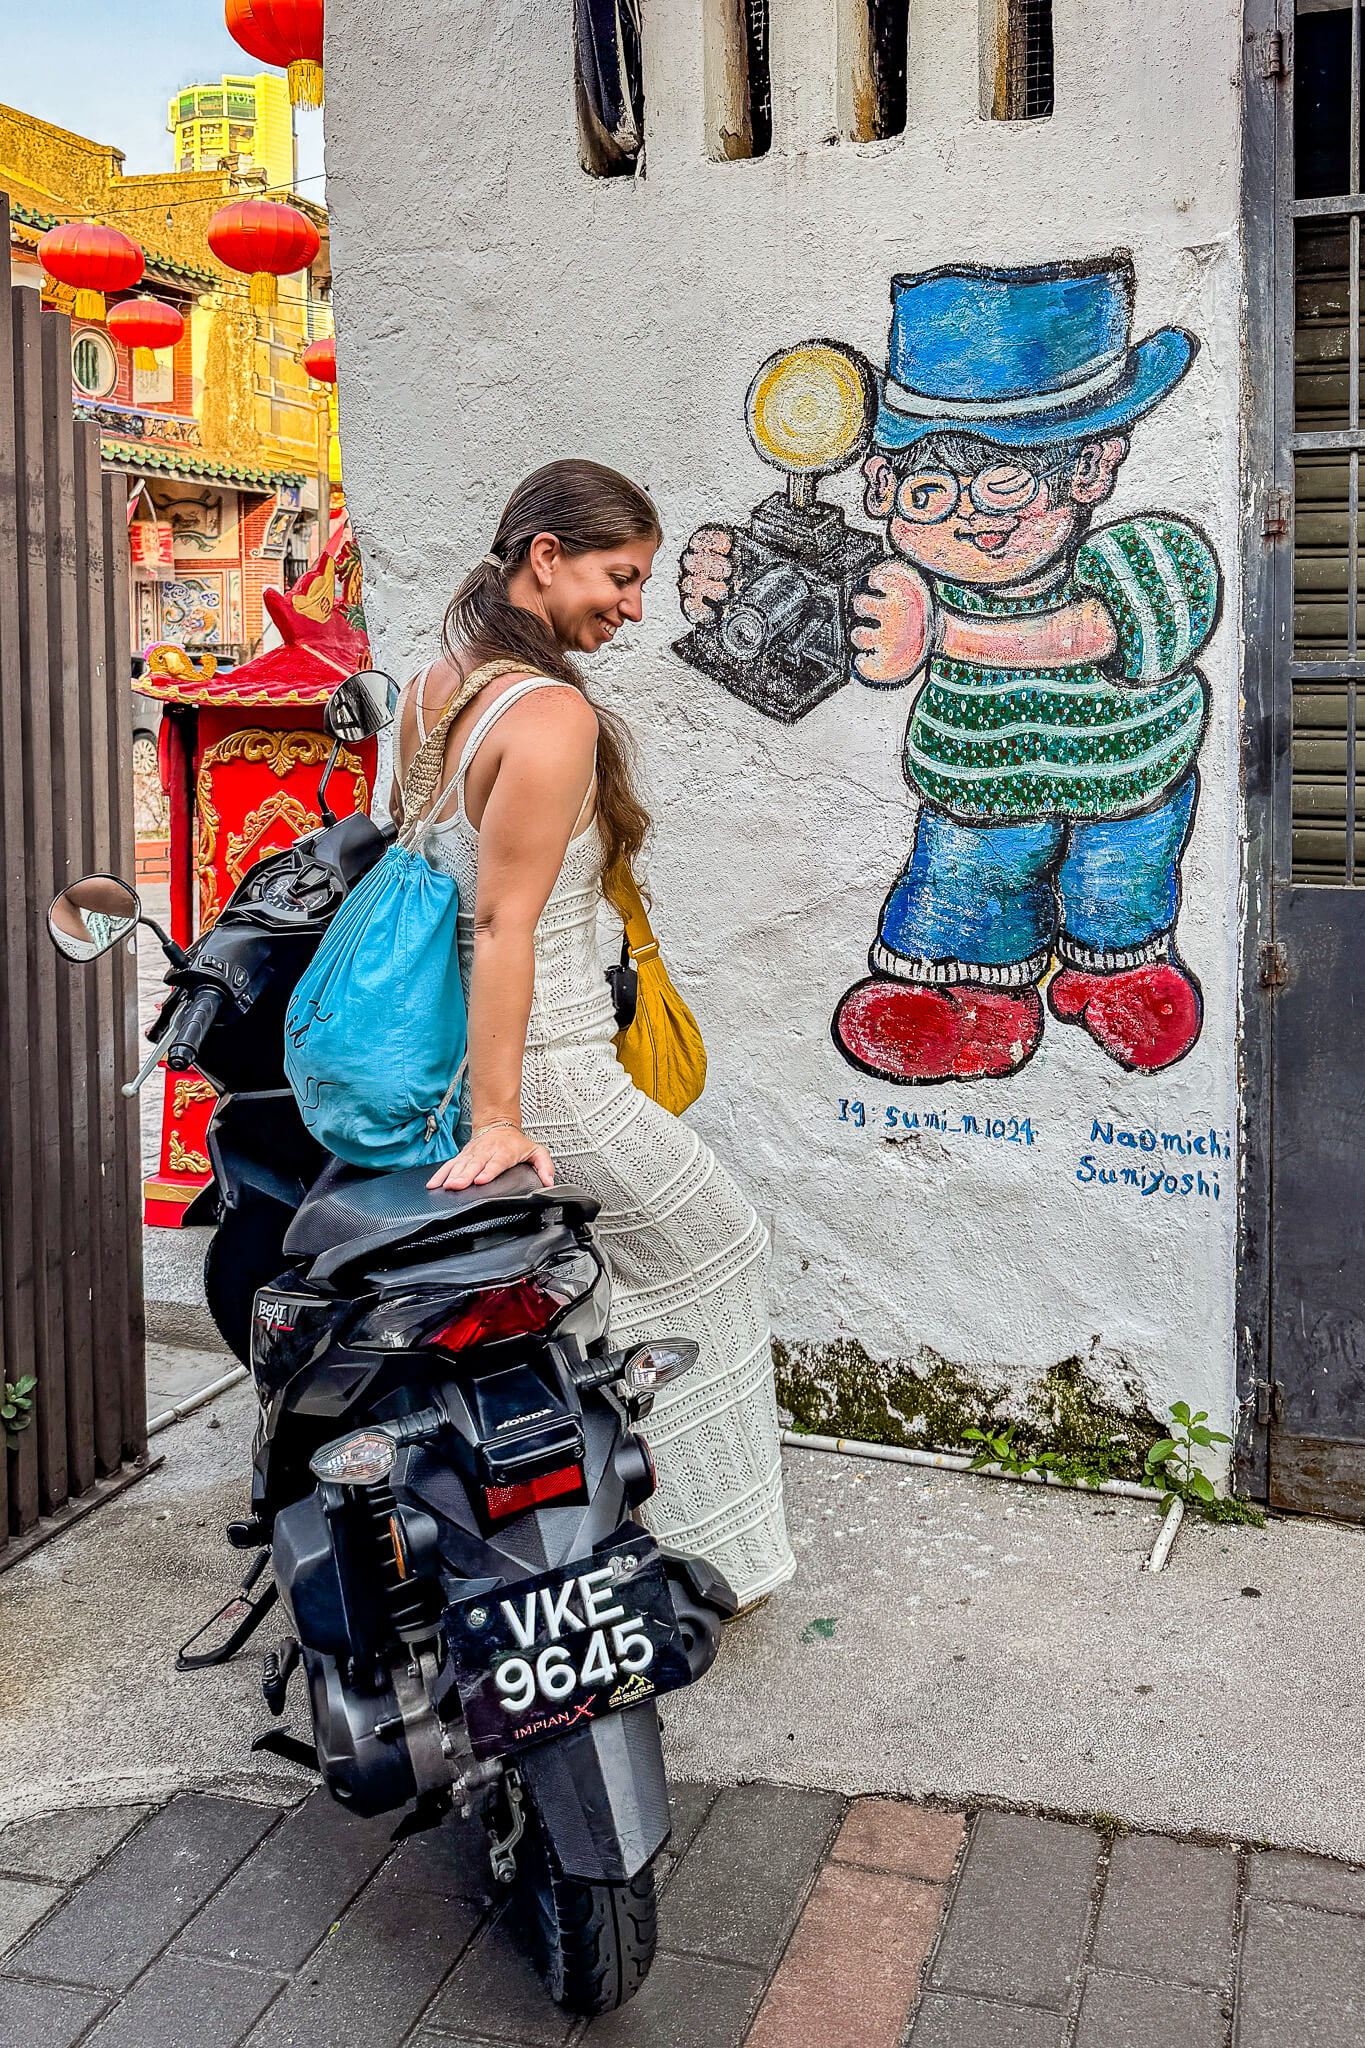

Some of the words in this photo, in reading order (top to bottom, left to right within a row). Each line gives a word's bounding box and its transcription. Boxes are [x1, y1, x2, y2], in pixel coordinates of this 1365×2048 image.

[885, 1105, 1038, 1146] sumi_n1024
[1090, 1119, 1231, 1160] Naomichi
[1076, 1154, 1220, 1200] Sumiyoshi
[496, 1408, 554, 1430] HONDA
[500, 1566, 625, 1649] VKE
[495, 1616, 654, 1712] 9645
[514, 1711, 569, 1739] IMPIAN
